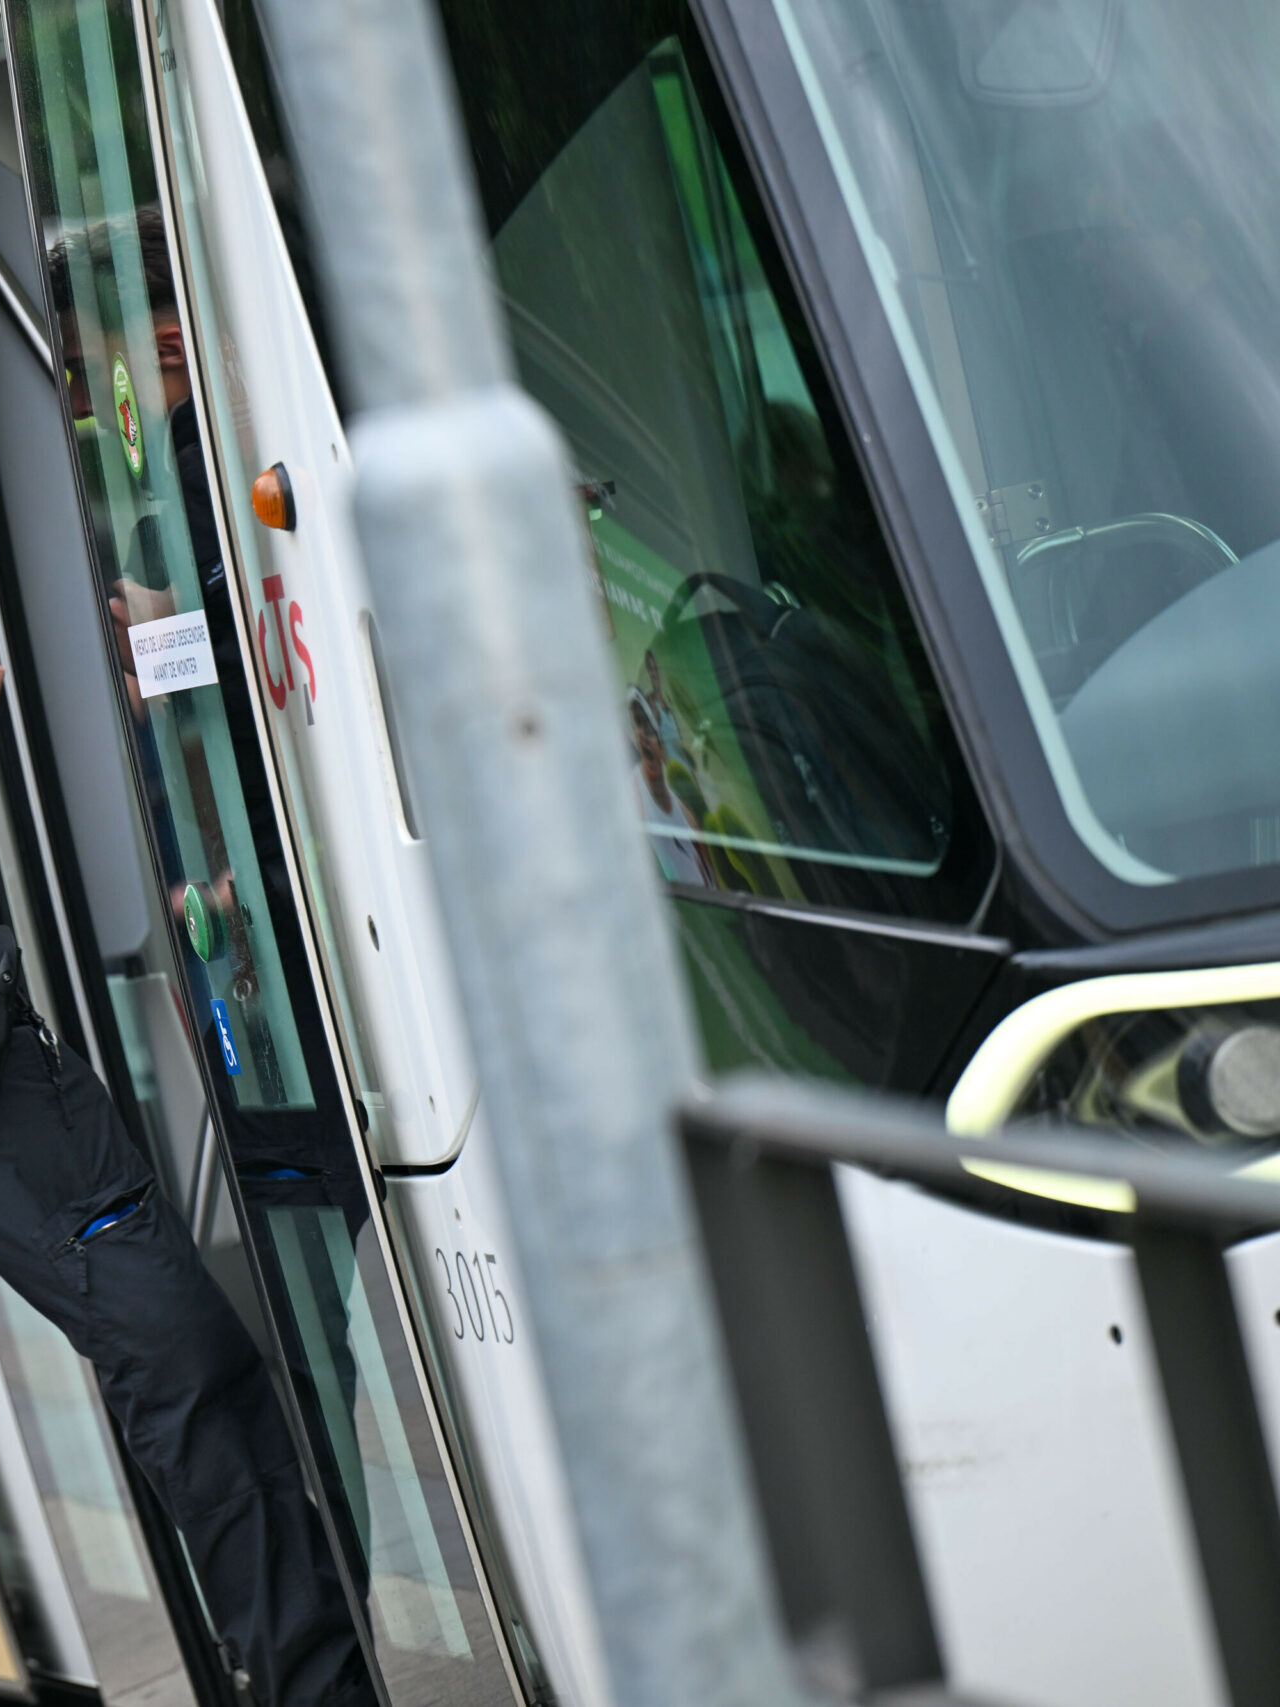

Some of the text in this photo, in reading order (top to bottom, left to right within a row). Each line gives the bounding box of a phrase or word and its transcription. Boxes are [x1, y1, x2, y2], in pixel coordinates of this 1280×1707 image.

[133, 638, 150, 656] MERCI
[156, 631, 177, 652] LAISSER
[175, 625, 207, 647] DESCENDRE
[153, 662, 169, 681] AVANT
[176, 657, 198, 676] MONTER
[258, 574, 316, 710] CTS
[435, 1247, 514, 1344] 3015
